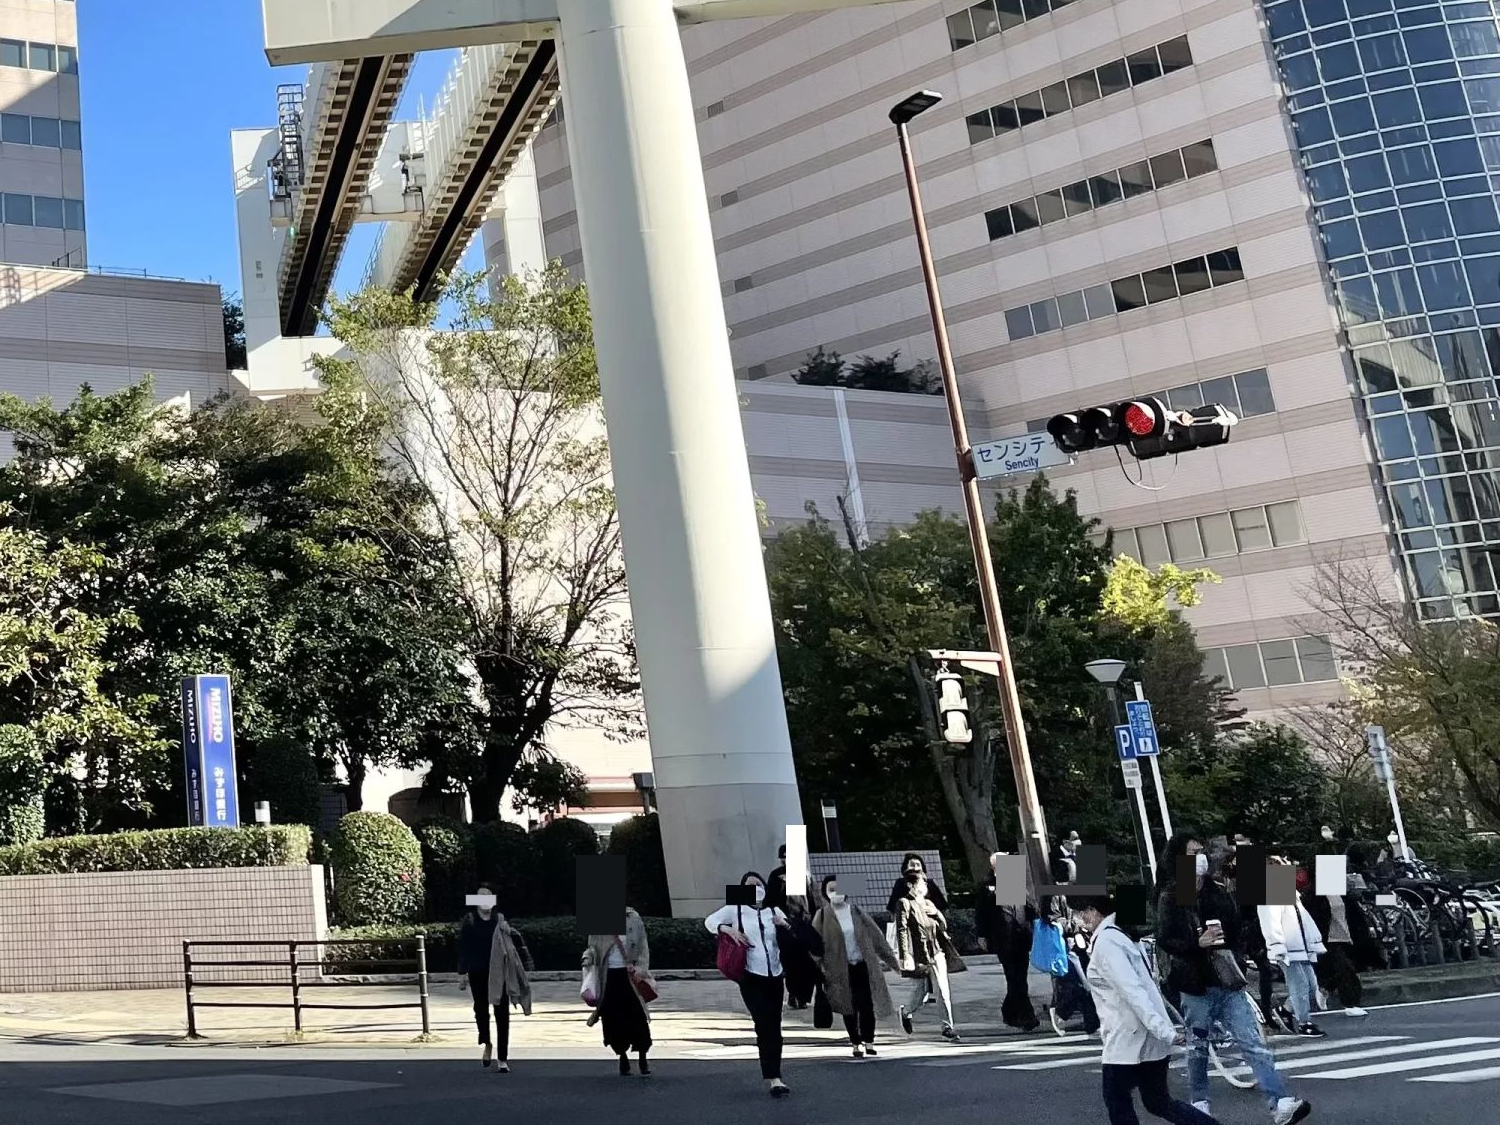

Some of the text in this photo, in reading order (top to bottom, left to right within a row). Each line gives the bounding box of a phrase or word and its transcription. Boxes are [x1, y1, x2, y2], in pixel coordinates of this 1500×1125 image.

[977, 437, 1054, 463] センシテ
[1004, 456, 1040, 471] Sencity
[186, 689, 196, 744] MIZUHO
[210, 687, 224, 744] MIZUHO
[1119, 730, 1130, 756] P
